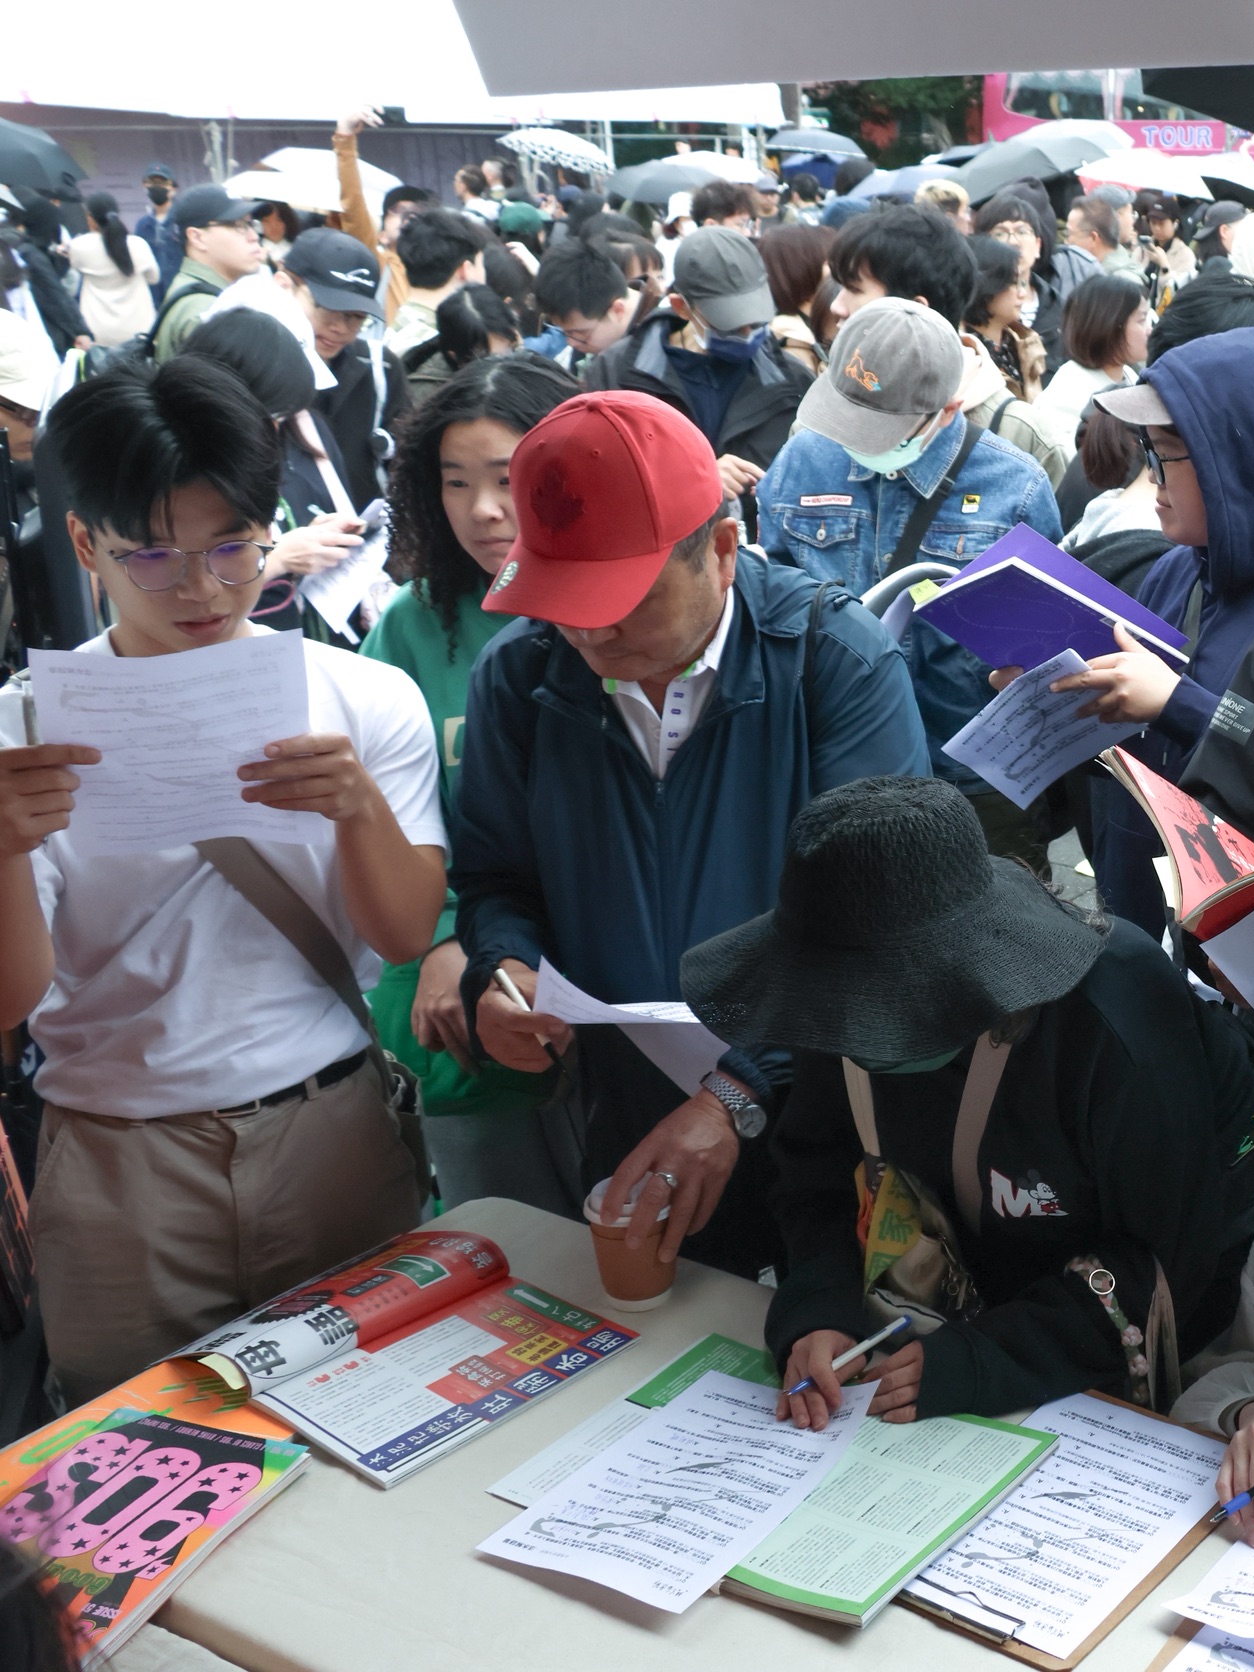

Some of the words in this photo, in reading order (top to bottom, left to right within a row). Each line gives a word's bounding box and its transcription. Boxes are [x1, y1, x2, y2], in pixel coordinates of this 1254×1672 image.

[1142, 126, 1212, 147] TOUR
[173, 1426, 201, 1436] MEMORY
[98, 1607, 122, 1620] ISSUE
